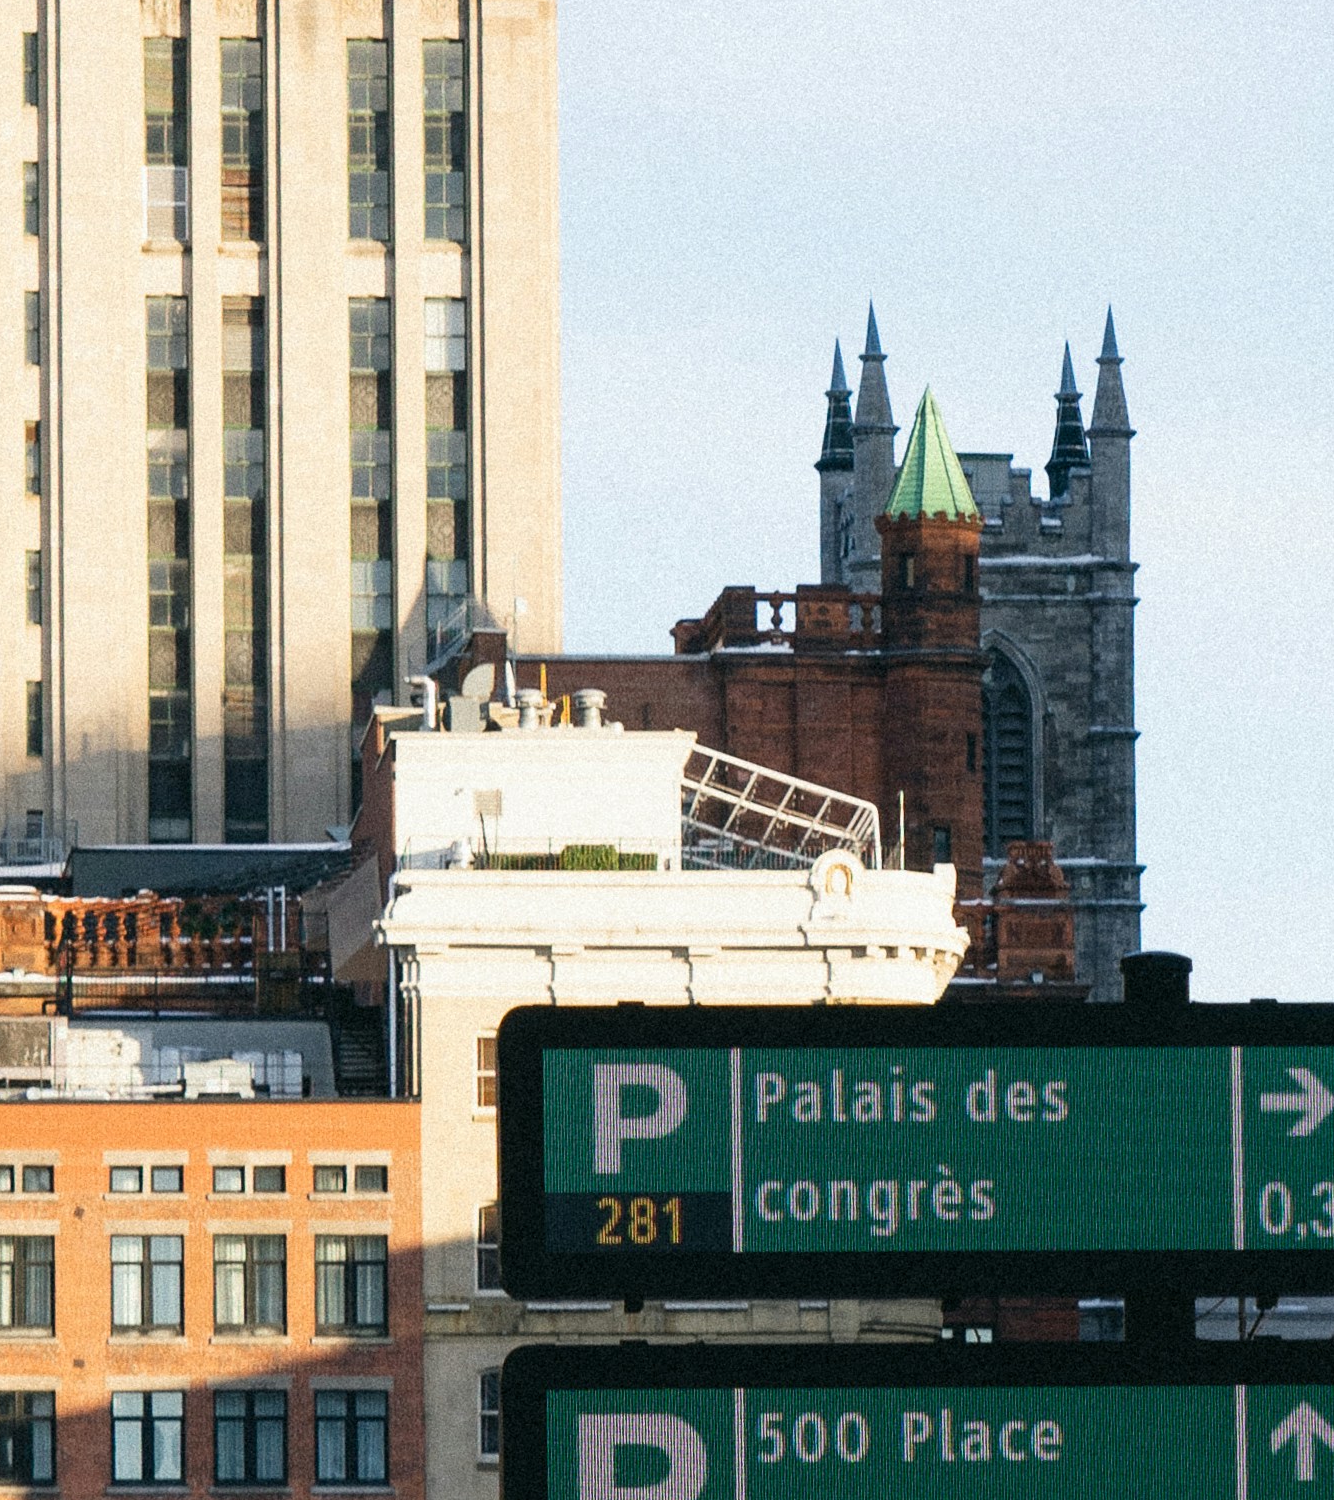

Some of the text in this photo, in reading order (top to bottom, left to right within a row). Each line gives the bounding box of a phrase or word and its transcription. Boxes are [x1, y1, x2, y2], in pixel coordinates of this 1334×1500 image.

[593, 1063, 688, 1174] P
[755, 1067, 1069, 1123] Palais des
[595, 1195, 683, 1245] 281
[755, 1165, 996, 1237] congrès
[757, 1408, 1064, 1464] 500 Place
